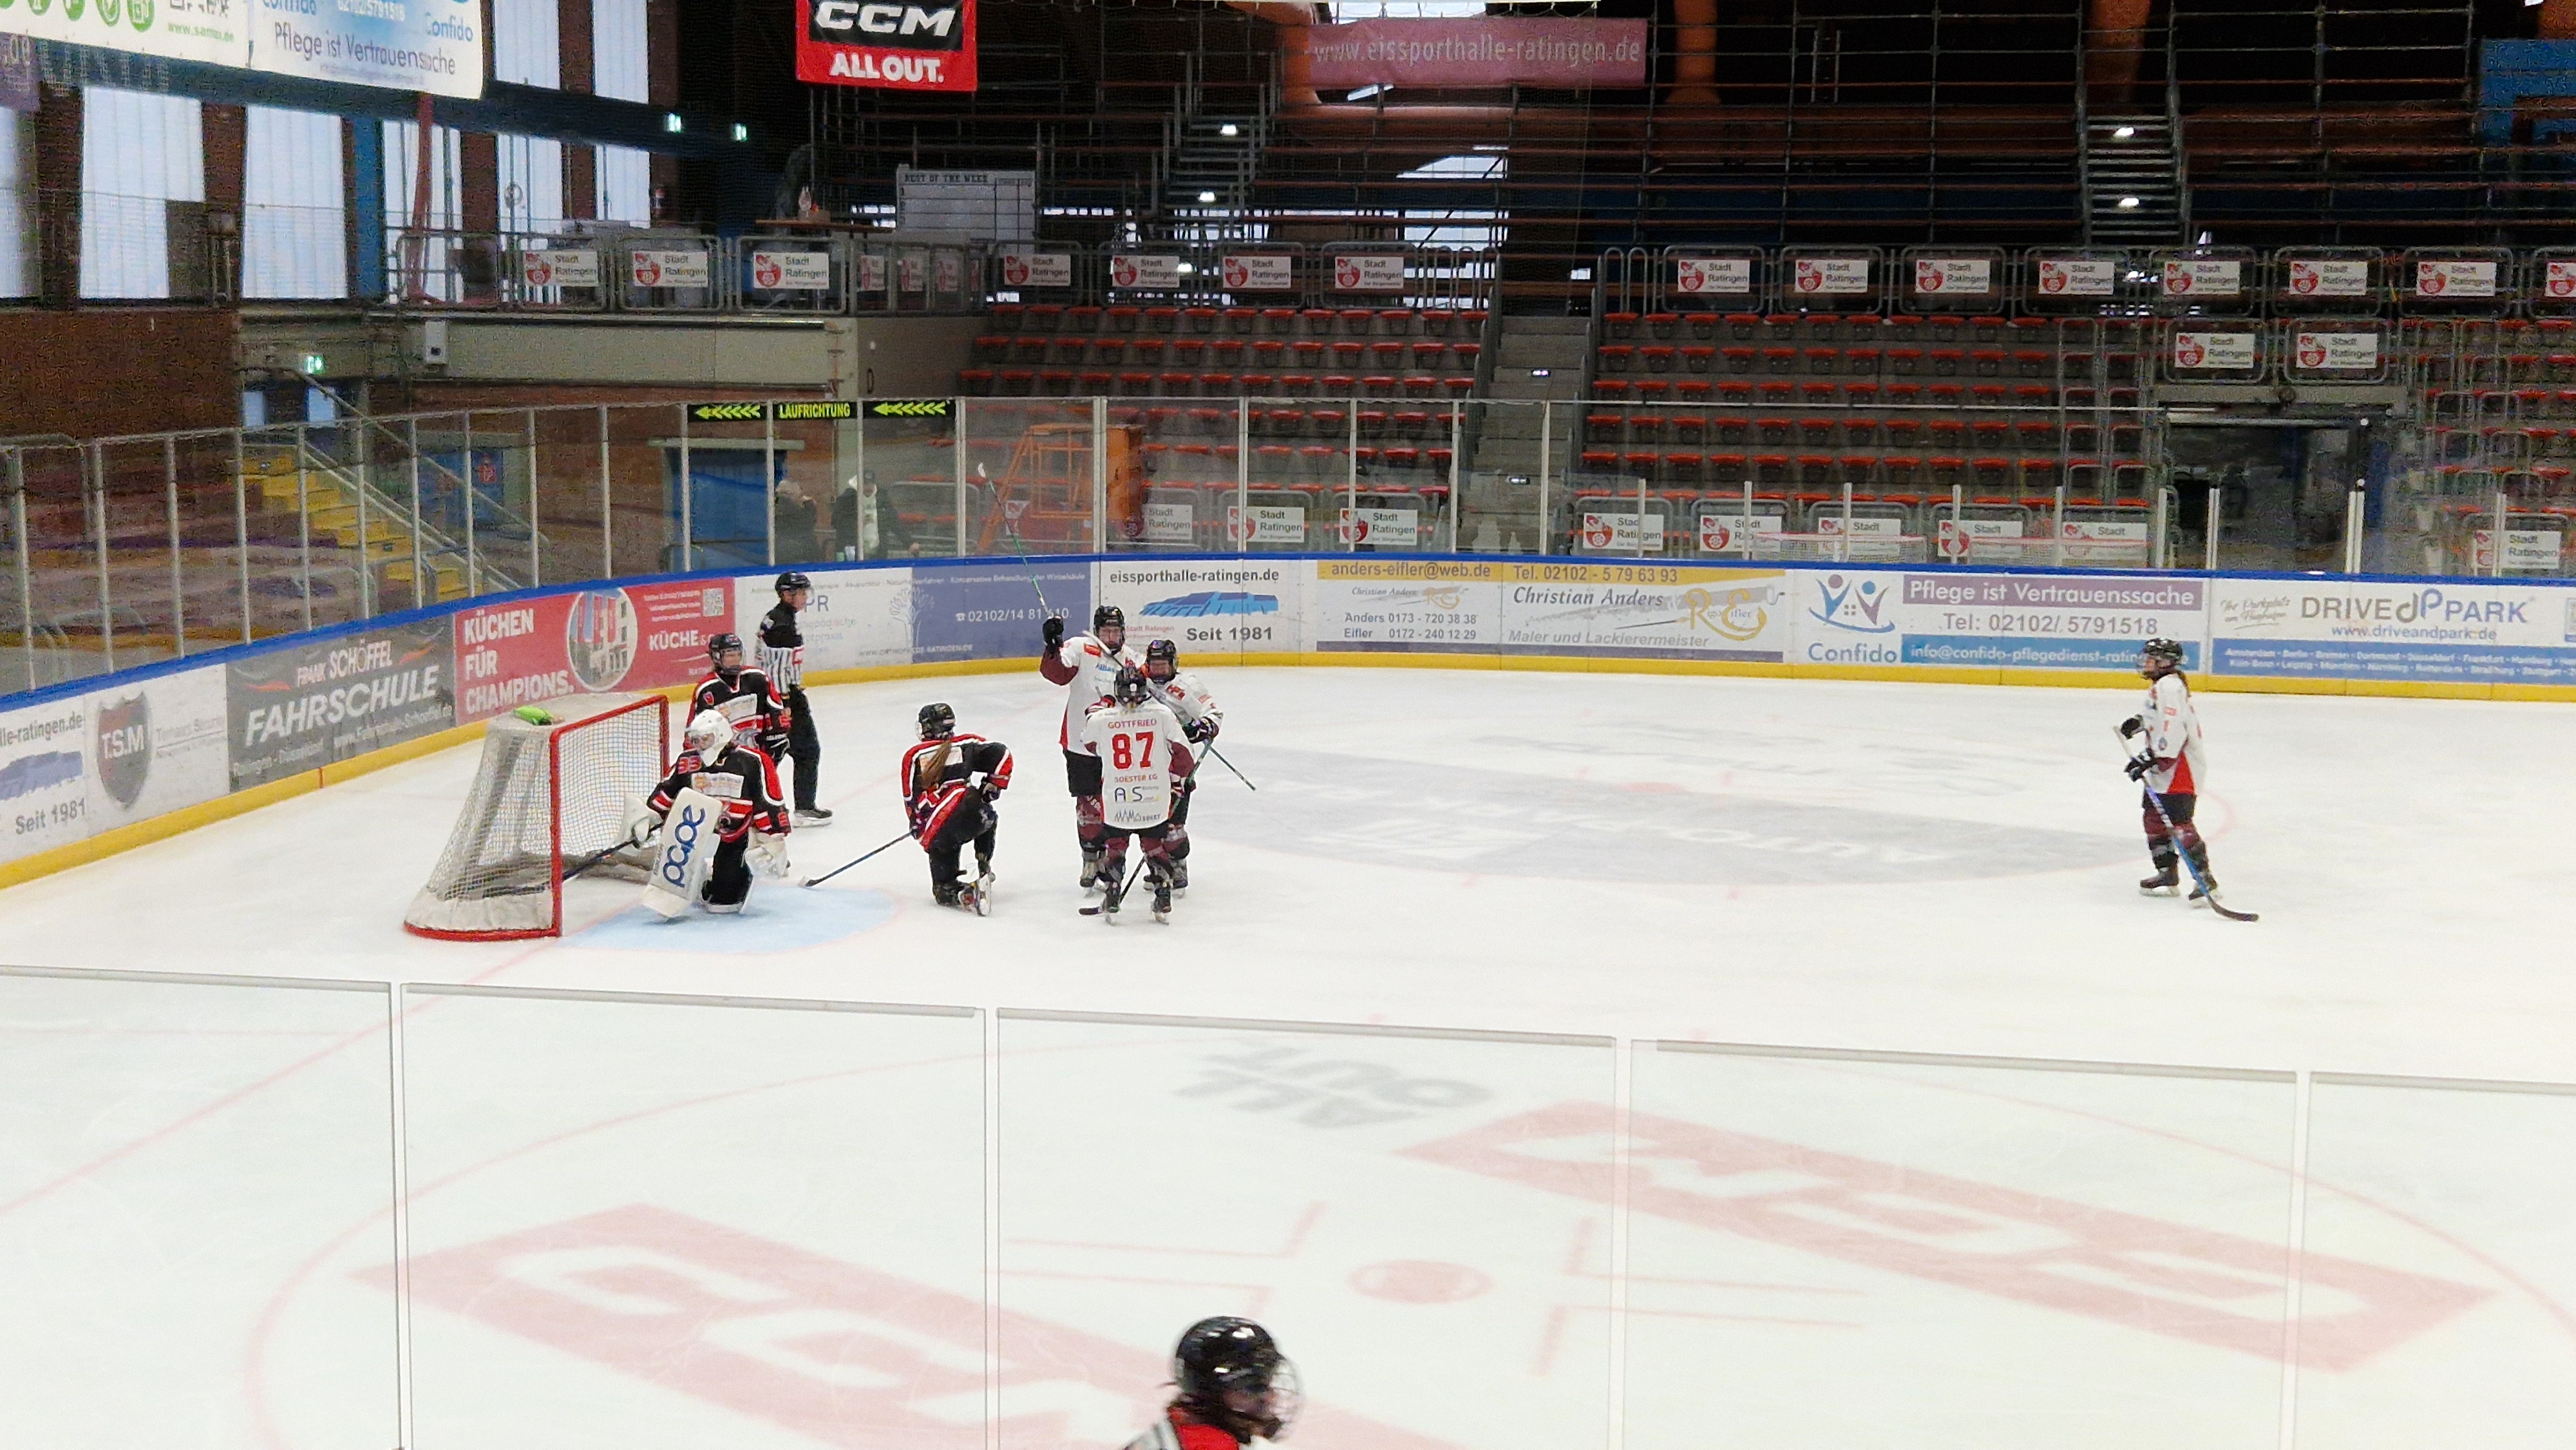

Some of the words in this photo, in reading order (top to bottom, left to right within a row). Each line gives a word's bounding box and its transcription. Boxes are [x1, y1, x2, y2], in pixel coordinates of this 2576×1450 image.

[816, 1, 955, 37] CCM
[275, 21, 321, 62] Pflege
[327, 30, 341, 57] ist
[1315, 33, 1640, 69] www.eissporthalle-ratingen.de
[830, 52, 880, 79] ALL
[1141, 259, 1163, 267] Stadt
[1252, 259, 1274, 267] Stadt
[1364, 259, 1387, 267] Stadt
[1708, 263, 1732, 272] Stadt
[1826, 263, 1850, 272] Stadt
[1141, 270, 1179, 279] Ratingen
[1252, 270, 1289, 279] Ratingen
[1364, 270, 1403, 279] Ratingen
[1708, 274, 1747, 284] Ratingen
[779, 404, 850, 419] LAUFRICHTUNG
[1260, 510, 1285, 519] Stadt
[1372, 512, 1398, 522] Stadt
[1148, 519, 1191, 530] Ratingen
[1260, 522, 1303, 534] Ratingen
[1372, 524, 1416, 536] Ratingen
[1853, 522, 1880, 531] Stadt
[1974, 524, 2001, 534] Stadt
[1617, 529, 1662, 541] Ratigen
[1110, 568, 1279, 585] eissporthalle-ratingen.de
[1332, 562, 1491, 579] anders-eifler@web.de
[1513, 565, 1539, 579] Tel.
[1544, 566, 1587, 580] 02102
[1603, 567, 1610, 581] 5
[1616, 567, 1633, 581] 79
[1639, 568, 1655, 581] 63
[1661, 569, 1678, 582] 93
[1513, 586, 1594, 605] Christian
[1601, 588, 1664, 607] Anders
[1910, 579, 1975, 604] Pflege
[1983, 581, 2007, 601] ist
[2013, 582, 2193, 606] Vertrauenssache
[968, 608, 1024, 623] 02102/14
[1028, 608, 1041, 619] 81
[1345, 612, 1385, 623] Anders
[1388, 613, 1414, 623] 0173
[1425, 613, 1444, 623] 720
[1448, 614, 1461, 624] 38
[1463, 614, 1477, 624] 38
[464, 607, 535, 645] KÜCHEN
[1944, 612, 1981, 631] Tel:
[2067, 616, 2157, 635] 5791518
[649, 629, 699, 652] KÜCHE
[1186, 627, 1223, 641] Seit
[1229, 626, 1273, 641] 1981
[1344, 627, 1373, 638] Eifler
[1388, 628, 1414, 639] 0172
[1425, 629, 1444, 639] 240
[1449, 629, 1460, 639] 12
[1463, 630, 1477, 640] 29
[1509, 629, 1549, 643] Maler
[1553, 632, 1582, 643] und
[1586, 632, 1709, 647] Lackierermeister
[2331, 625, 2497, 641] www.driveandpark.de
[1808, 642, 1897, 664] Confido
[298, 663, 327, 687] FRANK
[330, 638, 393, 680] SCHÖFFEL
[465, 646, 498, 680] FÜR
[466, 670, 574, 715] CHAMPIONS.
[245, 665, 440, 747] FAHRSCHULE
[1108, 718, 1157, 729] GOTTFRIED
[1111, 731, 1156, 771] 87
[15, 810, 46, 835] Seit
[52, 797, 86, 825] 1981
